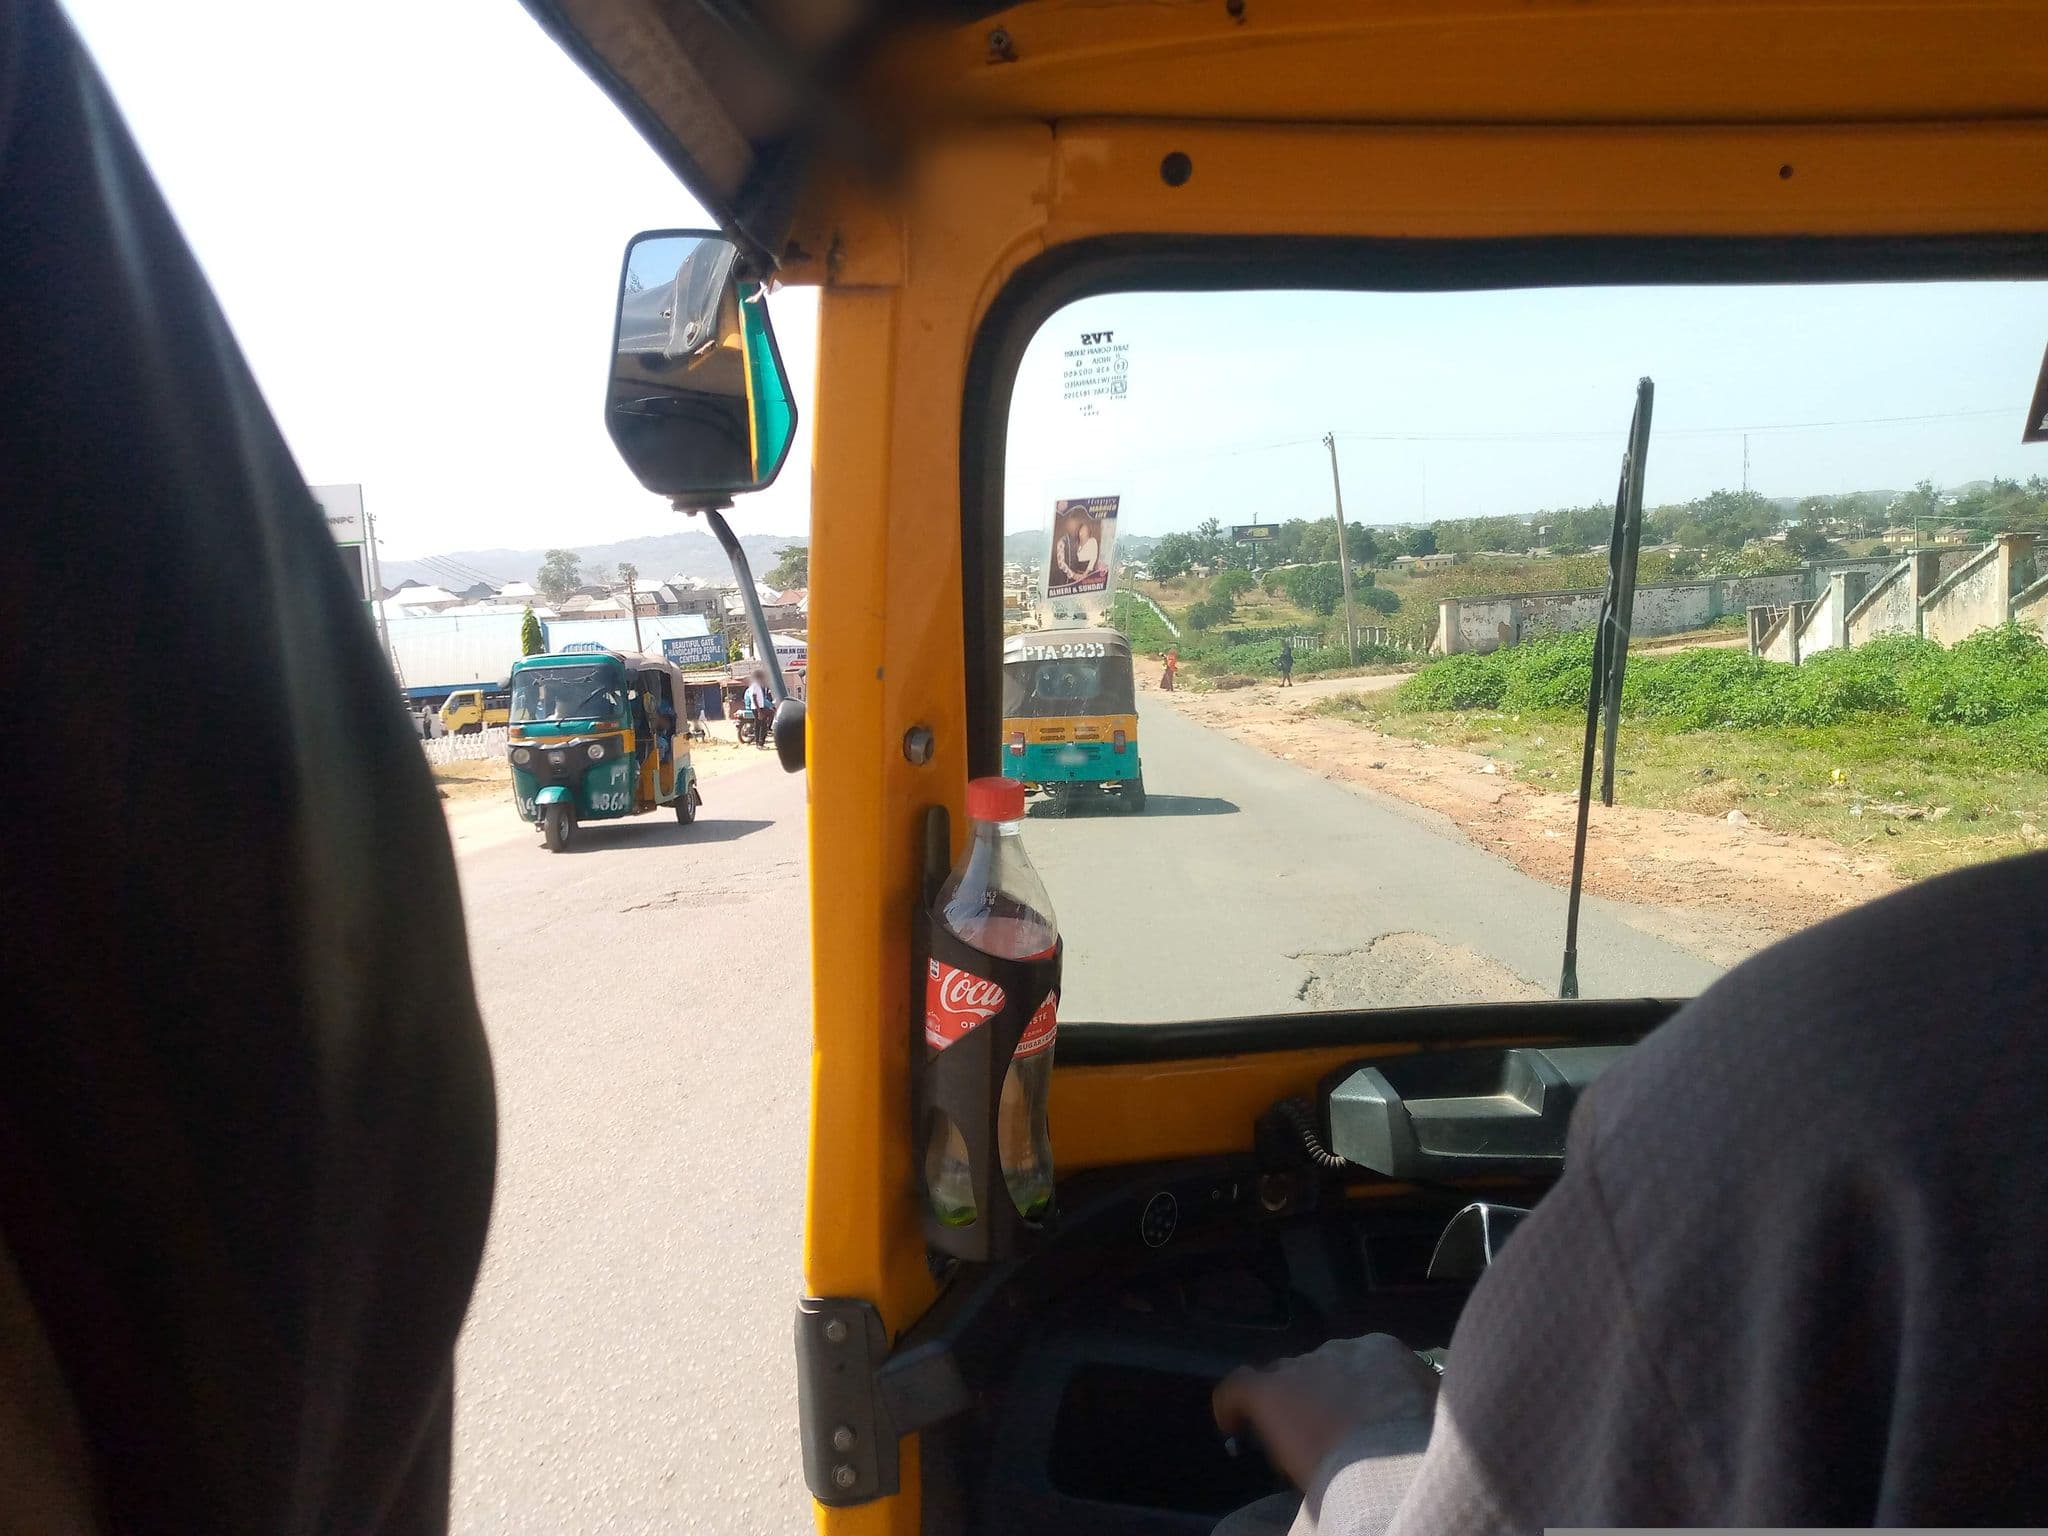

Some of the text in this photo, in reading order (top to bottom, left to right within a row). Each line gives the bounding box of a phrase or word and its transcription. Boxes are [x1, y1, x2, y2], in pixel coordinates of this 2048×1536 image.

[1078, 583, 1104, 593] SUNDAY
[671, 638, 714, 649] BEAUTIFUL GATE
[703, 646, 721, 654] PEOPLE
[679, 654, 711, 663] CENTER JOS
